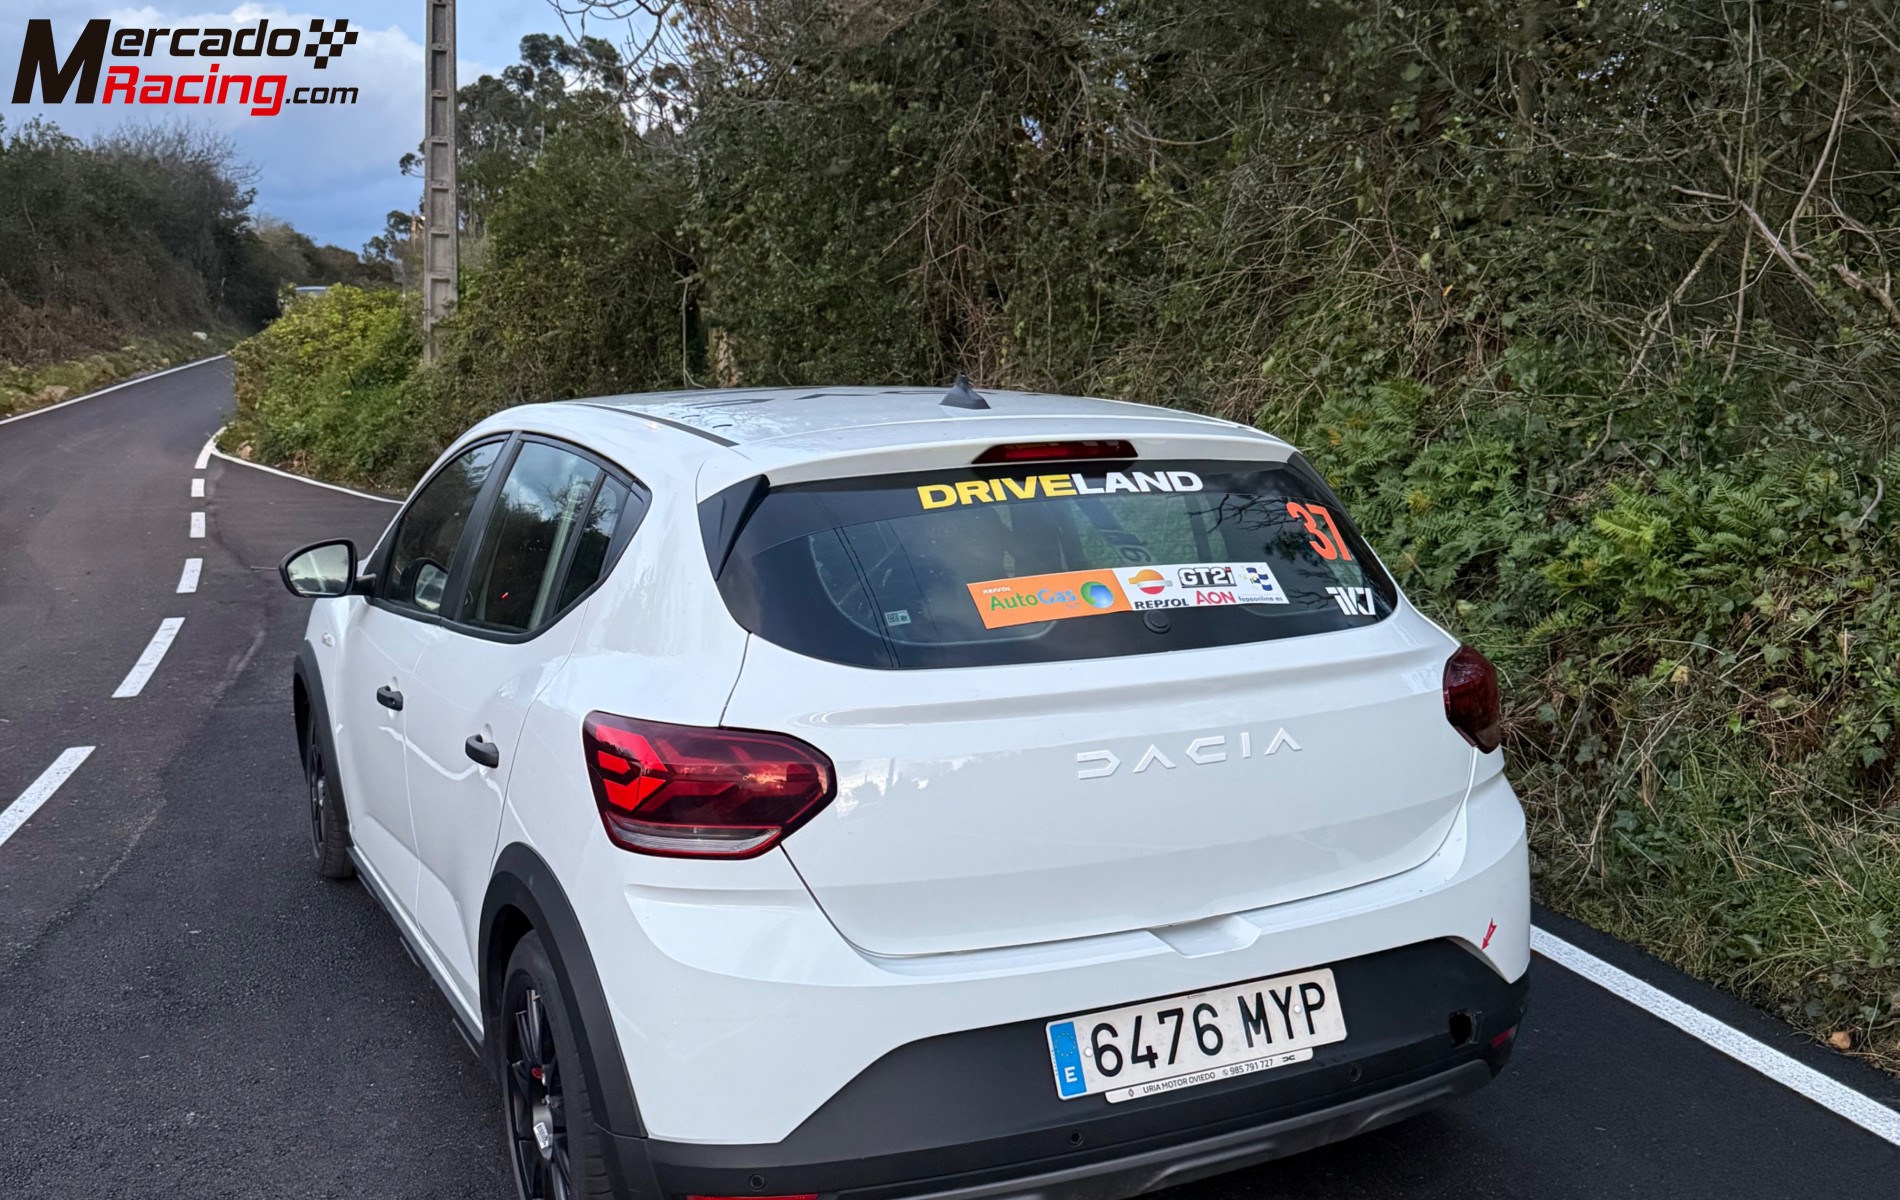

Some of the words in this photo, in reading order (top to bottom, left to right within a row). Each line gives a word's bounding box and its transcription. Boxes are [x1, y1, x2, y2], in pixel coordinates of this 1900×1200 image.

[917, 471, 1204, 510] DRIVELAND
[1286, 501, 1353, 561] 37
[1177, 566, 1237, 588] GT2i
[982, 586, 1012, 595] REPSOL
[990, 588, 1077, 611] AutoGas
[1195, 590, 1236, 605] AON
[1134, 598, 1189, 609] REPSOL
[1077, 727, 1303, 780] DACIA
[1091, 1002, 1224, 1077] 6476
[1237, 981, 1326, 1048] MYP
[1064, 1066, 1078, 1083] E
[1162, 1077, 1188, 1090] MOTOR
[1188, 1071, 1216, 1084] OVIEDO
[1229, 1065, 1245, 1076] 985
[1245, 1061, 1259, 1072] 791
[1260, 1058, 1273, 1069] 727
